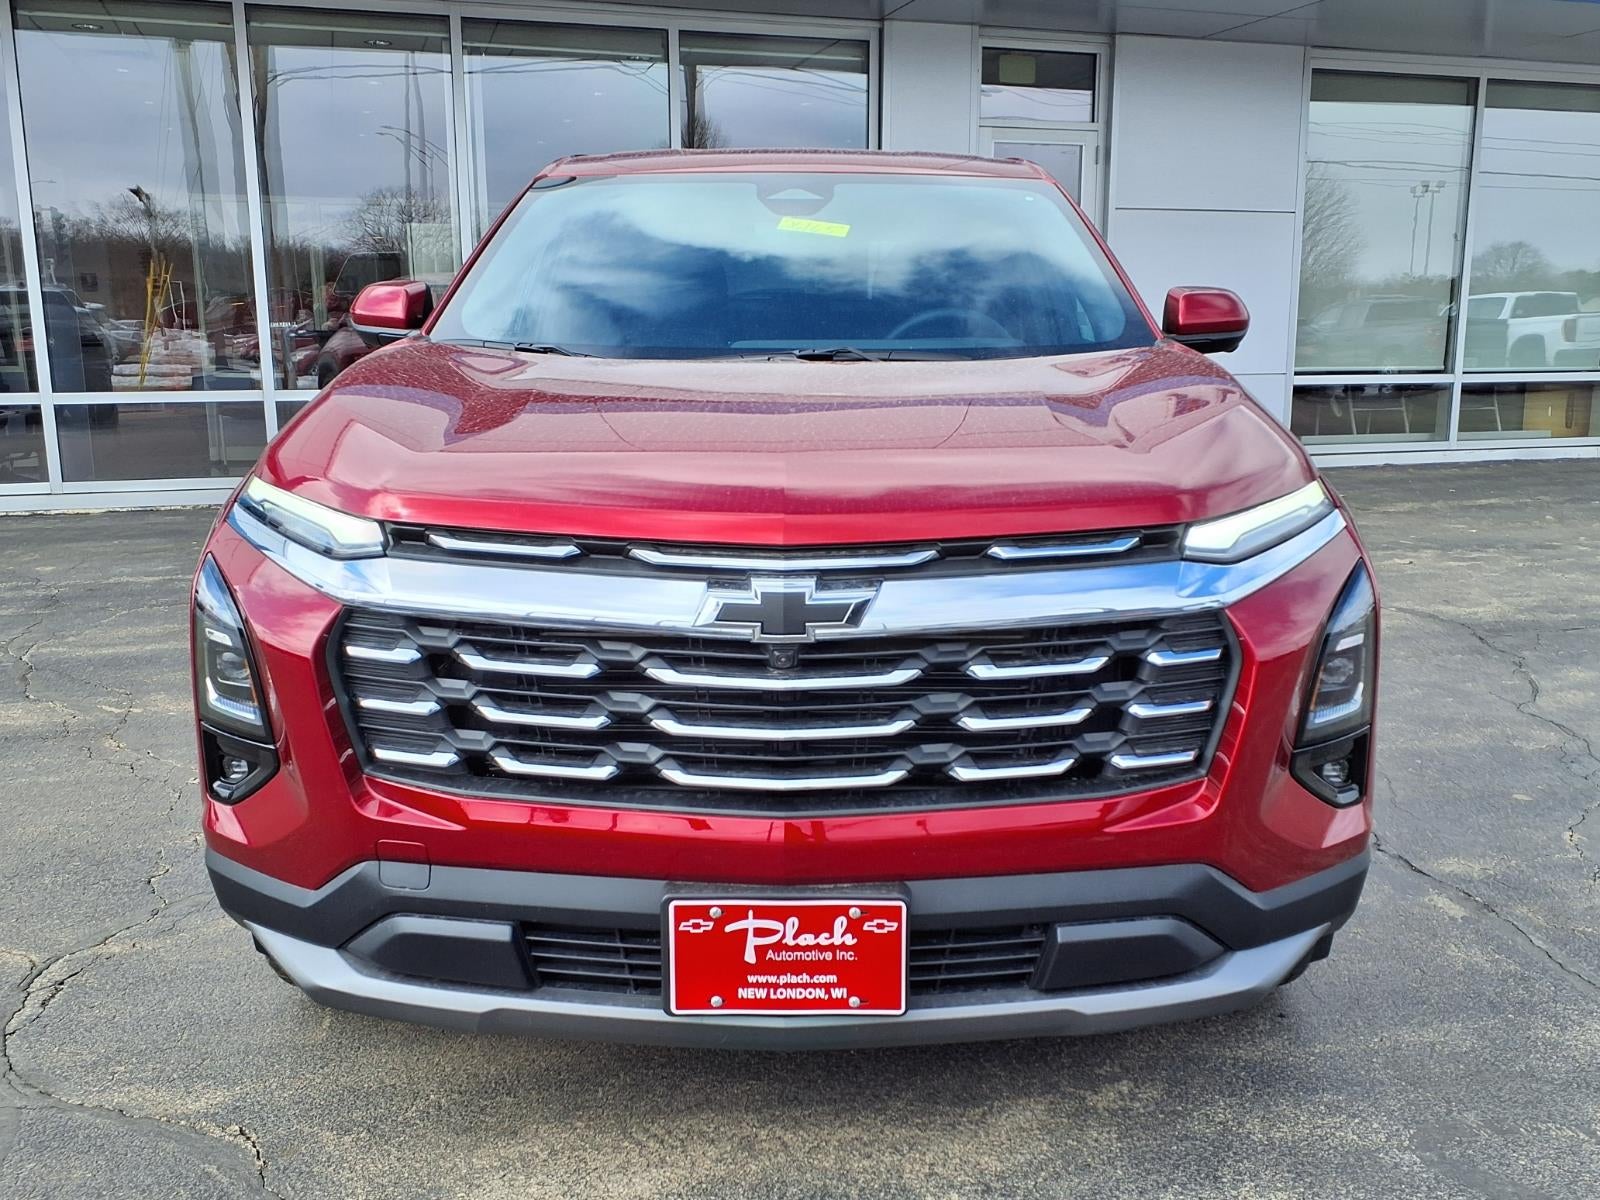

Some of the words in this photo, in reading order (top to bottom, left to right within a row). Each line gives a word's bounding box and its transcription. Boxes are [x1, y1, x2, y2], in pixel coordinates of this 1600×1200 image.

[725, 910, 857, 964] Plach
[766, 949, 832, 960] Automotive
[836, 949, 858, 960] Inc.
[747, 973, 837, 985] www.plach.com
[738, 988, 767, 999] NEW
[770, 988, 828, 1000] LONDON,
[831, 988, 847, 999] WI
